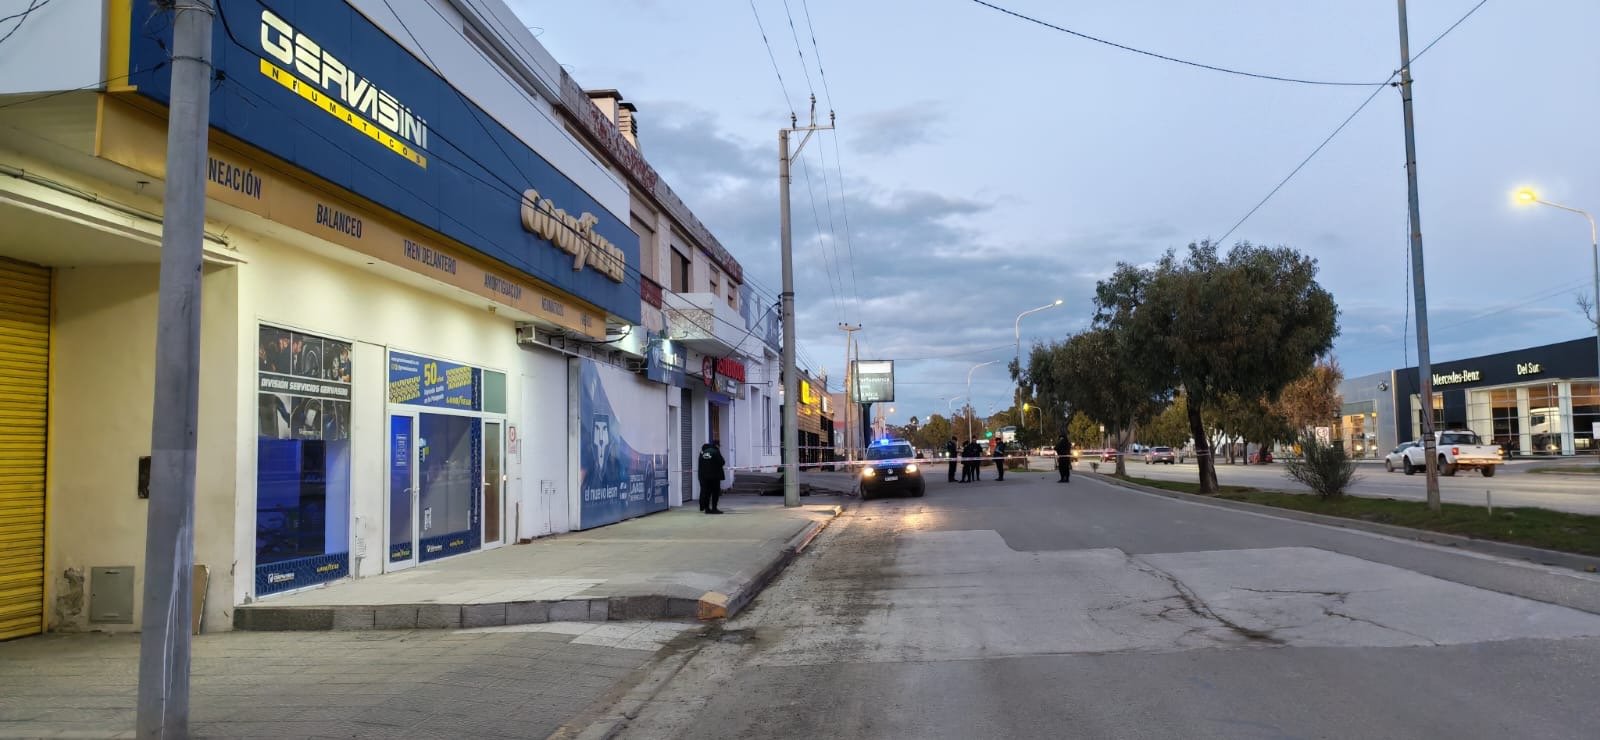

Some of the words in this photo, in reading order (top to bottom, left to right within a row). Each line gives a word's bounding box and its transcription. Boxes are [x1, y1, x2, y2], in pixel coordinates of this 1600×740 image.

[260, 9, 428, 150] GERVASINI
[272, 66, 421, 164] NEUMATICOS
[208, 157, 262, 201] NEACIÓN
[316, 203, 362, 239] BALANCEO
[403, 239, 420, 260] TREN
[422, 247, 457, 275] DELANTERO
[424, 362, 438, 386] 50
[1432, 369, 1480, 386] Mercedes-Benz
[1517, 363, 1528, 375] Del
[1528, 362, 1541, 374] Sur
[289, 382, 319, 393] SERVICIOS
